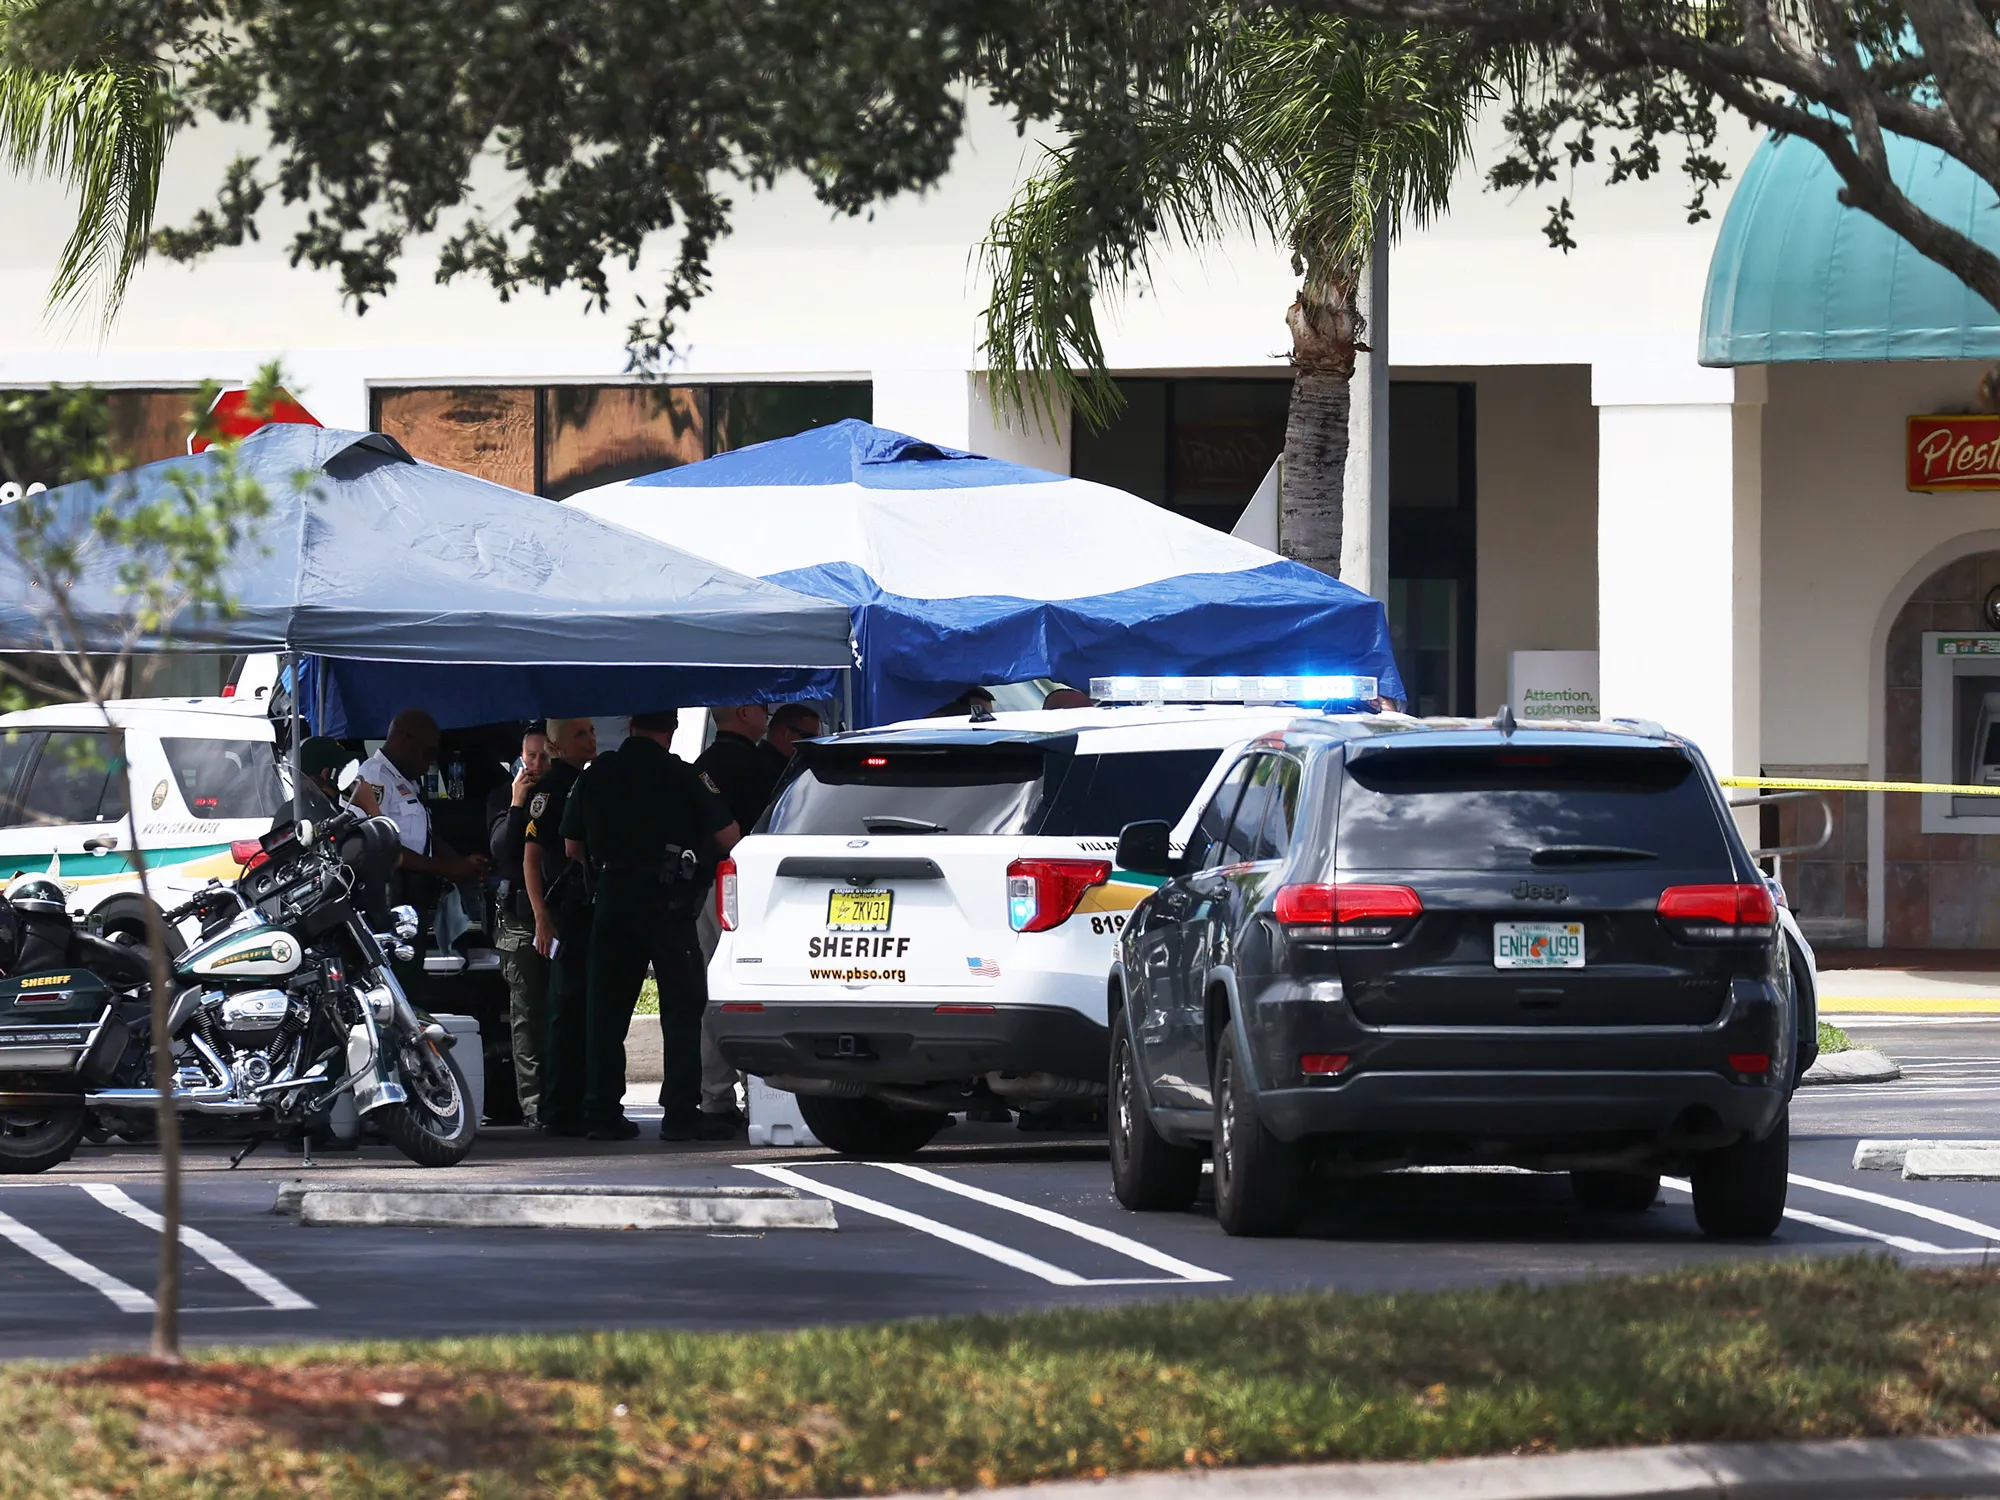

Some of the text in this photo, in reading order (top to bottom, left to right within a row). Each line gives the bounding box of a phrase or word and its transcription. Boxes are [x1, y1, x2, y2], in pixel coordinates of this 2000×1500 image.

[1523, 688, 1593, 702] Attention,
[1511, 880, 1570, 904] Jeep
[852, 901, 885, 921] ZKV31
[808, 936, 910, 958] SHERIFF
[1500, 935, 1579, 957] ENH U99
[217, 950, 270, 966] SHERIFF
[20, 975, 72, 988] SHERIFF
[809, 967, 906, 982] www.pbso.org
